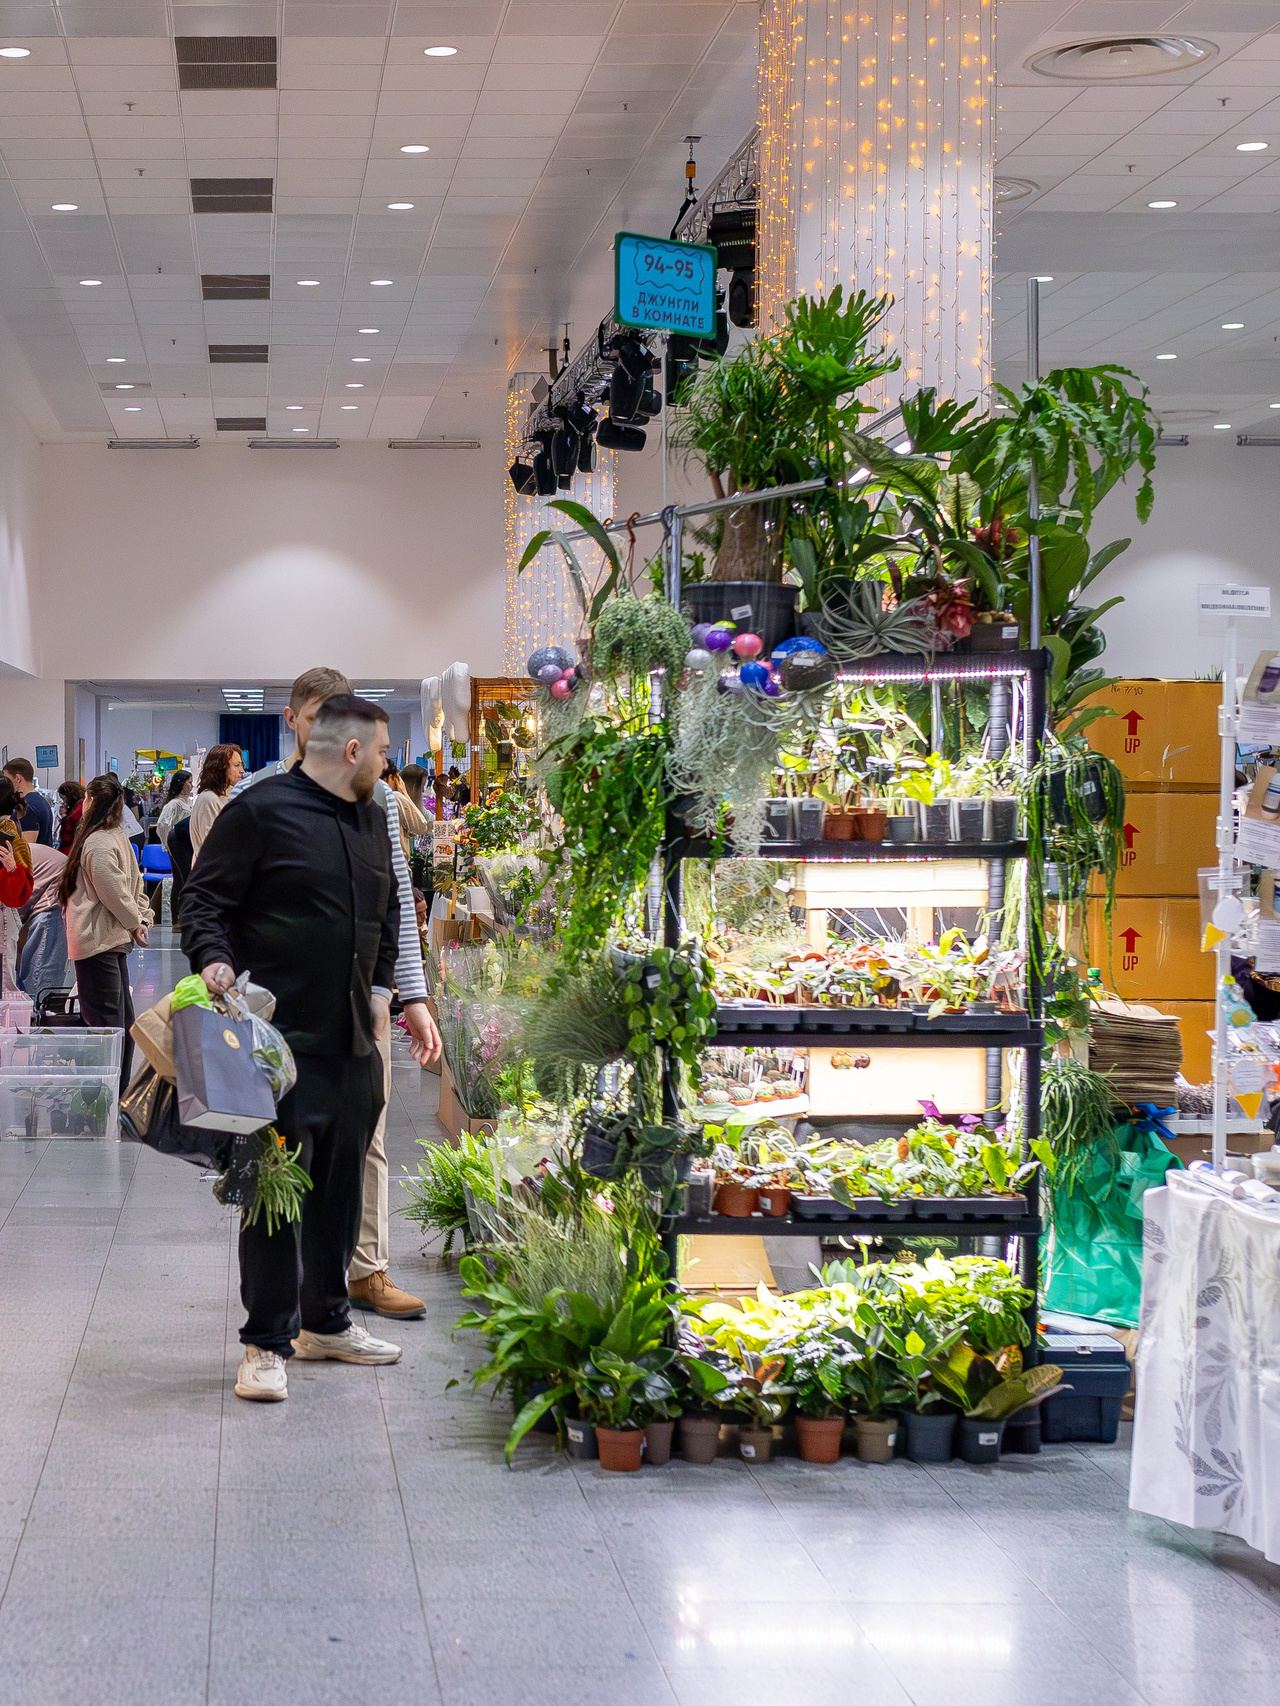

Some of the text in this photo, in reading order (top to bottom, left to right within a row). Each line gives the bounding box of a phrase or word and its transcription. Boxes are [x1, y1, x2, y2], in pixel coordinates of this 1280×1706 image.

[644, 253, 694, 279] 94-95
[637, 291, 699, 313] ДЖУНГЛИ
[632, 305, 705, 329] В КОМНАТЕ
[1124, 737, 1141, 754] UP
[1120, 850, 1137, 867] UP
[1122, 955, 1139, 971] UP
